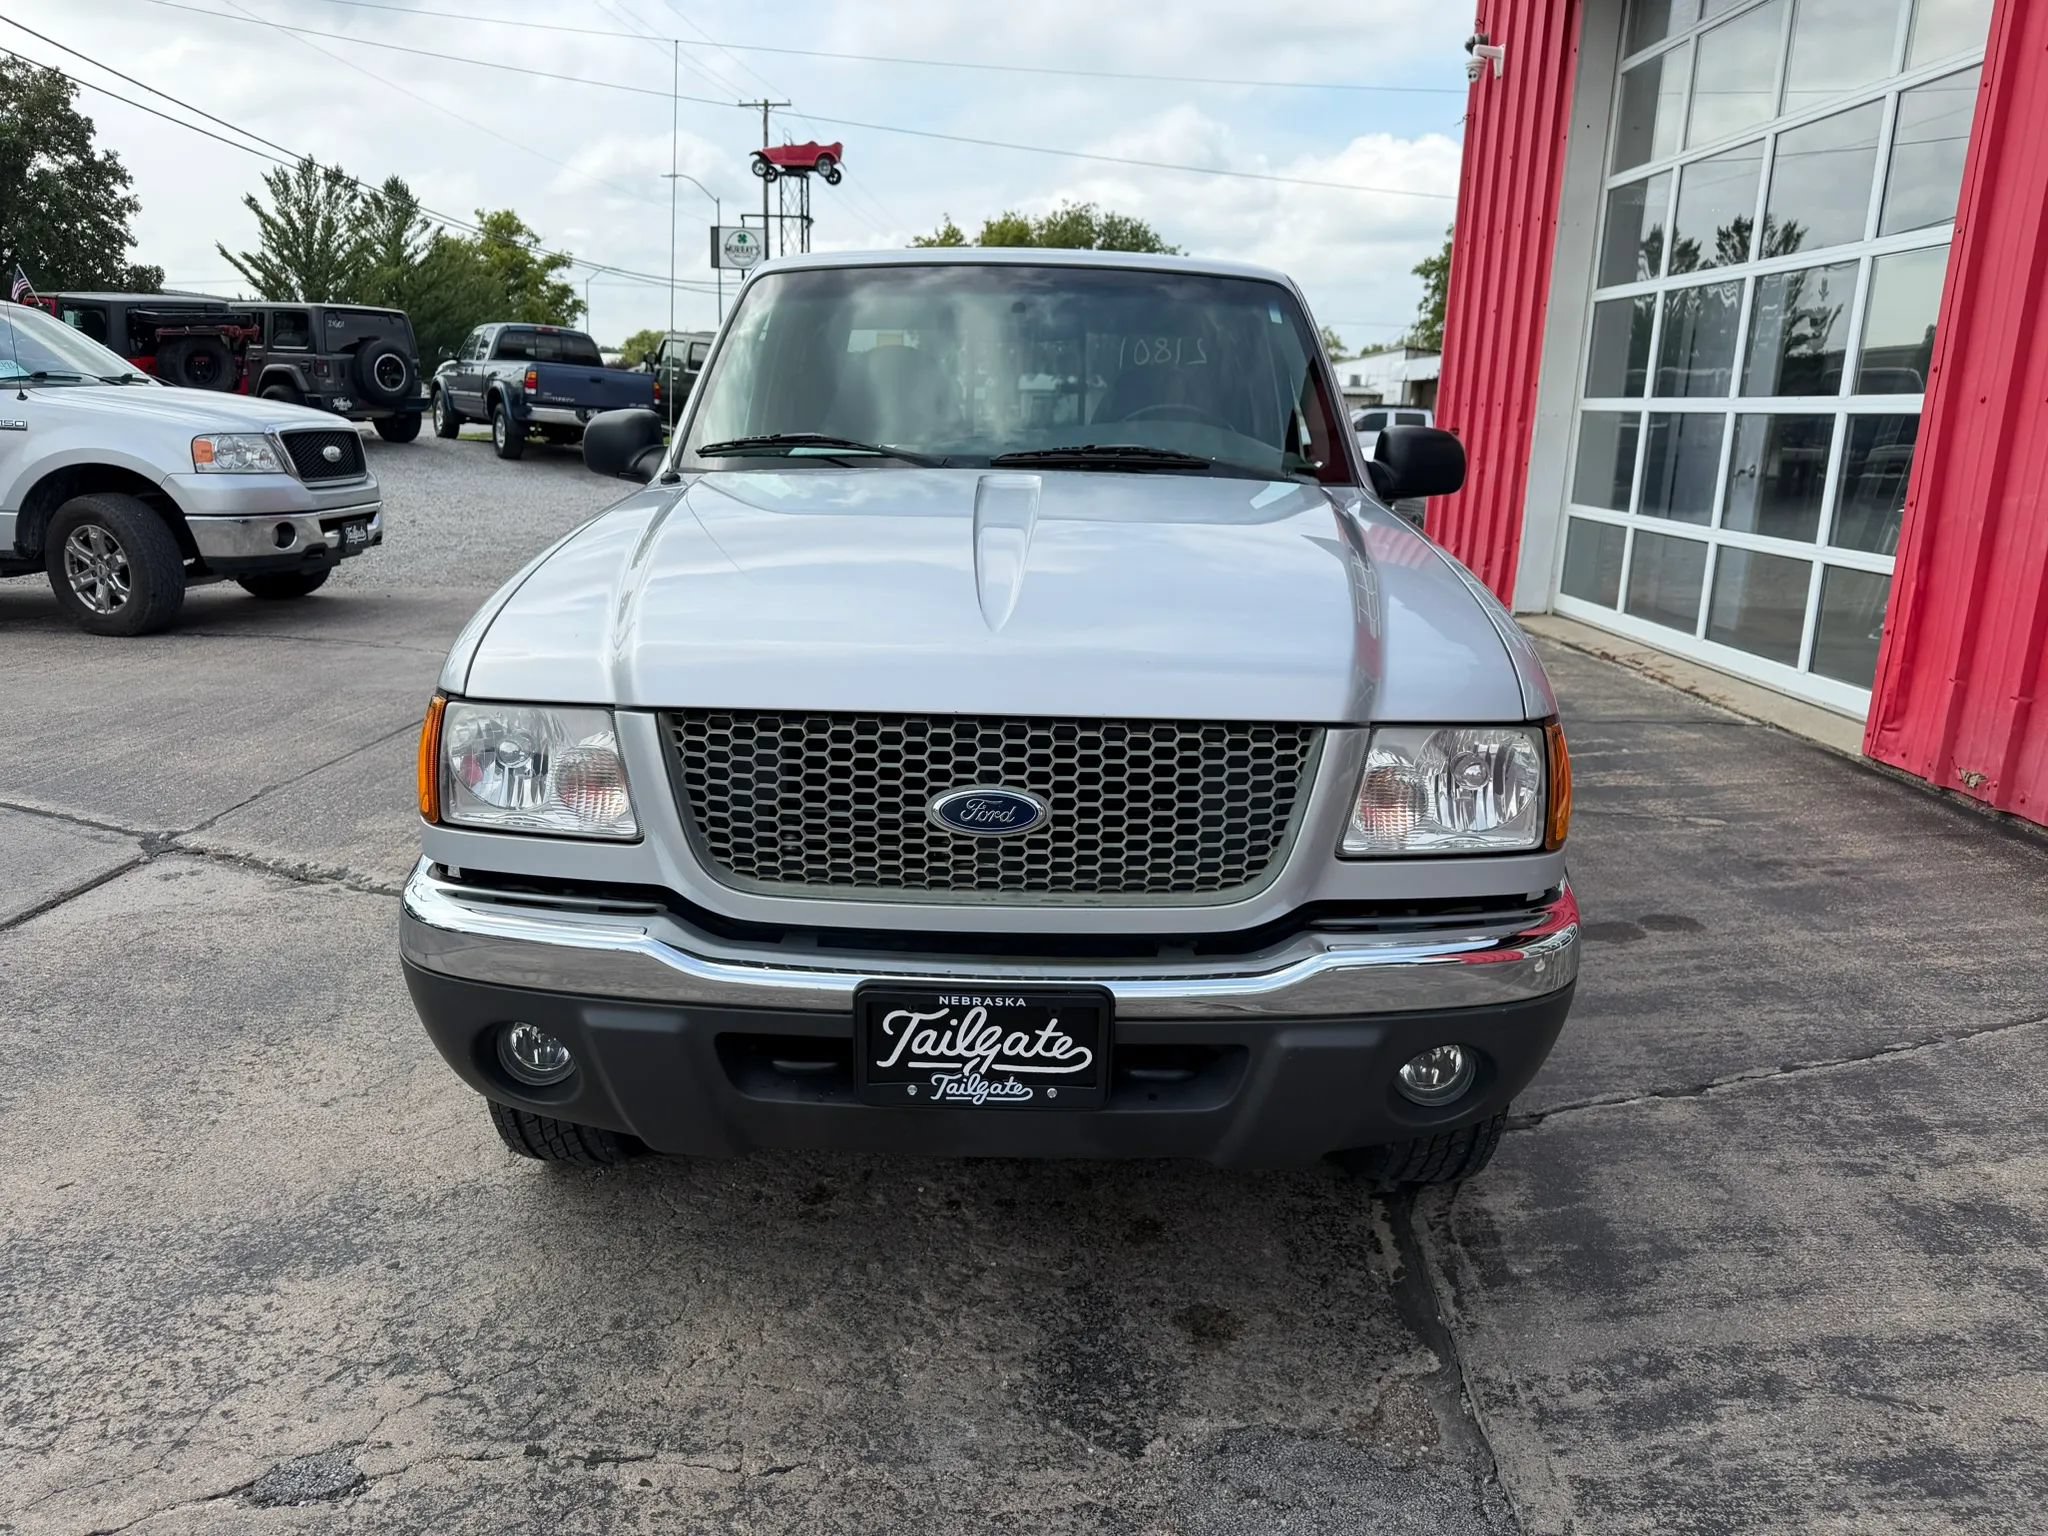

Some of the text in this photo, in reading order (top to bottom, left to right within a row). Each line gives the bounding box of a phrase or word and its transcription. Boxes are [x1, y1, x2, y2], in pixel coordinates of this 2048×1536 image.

[960, 798, 1017, 822] Ford
[938, 995, 1027, 1007] NEBRASKA
[876, 1006, 1093, 1076] Tailgate
[930, 1072, 1034, 1105] Tailgate
